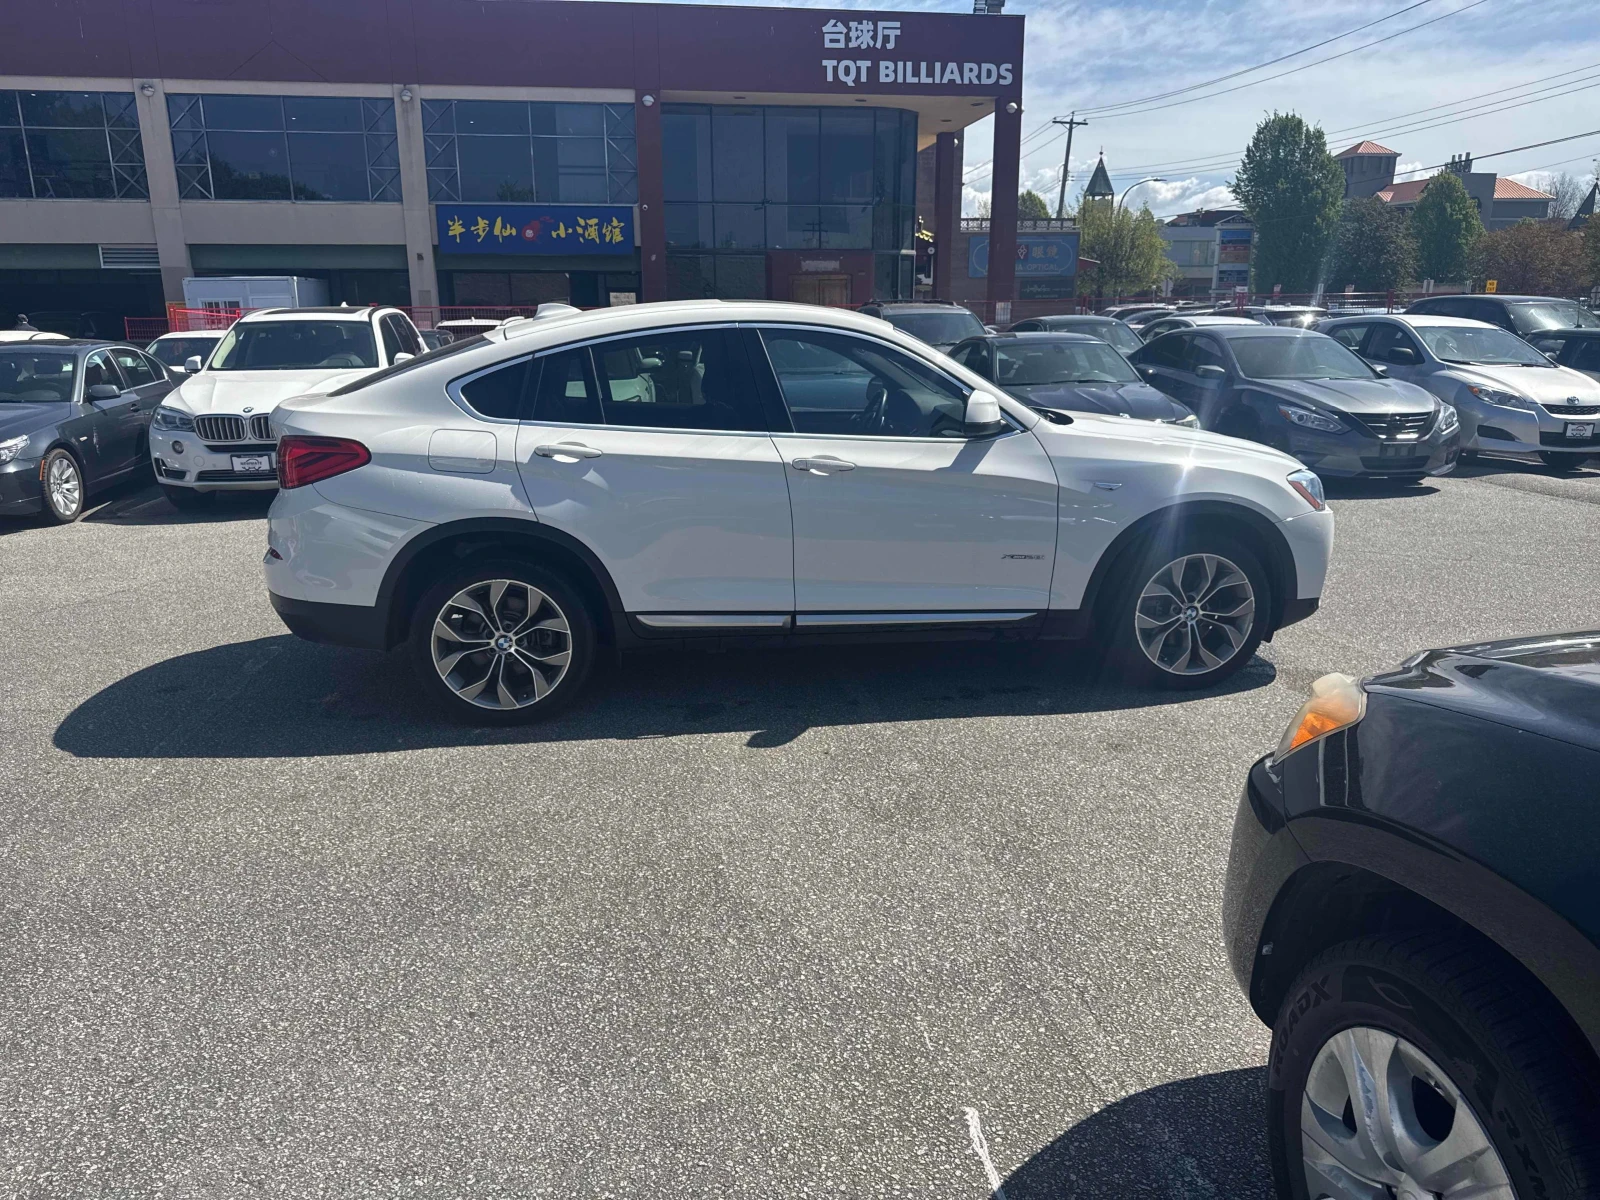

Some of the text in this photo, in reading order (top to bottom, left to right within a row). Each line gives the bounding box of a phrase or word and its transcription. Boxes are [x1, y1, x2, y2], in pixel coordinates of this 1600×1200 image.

[821, 19, 901, 50] 台球厅
[821, 59, 1013, 87] TQT BILLIARDS
[447, 215, 517, 243] 半步仙
[1026, 263, 1060, 272] OPTICAL
[1272, 974, 1333, 1079] ROADX
